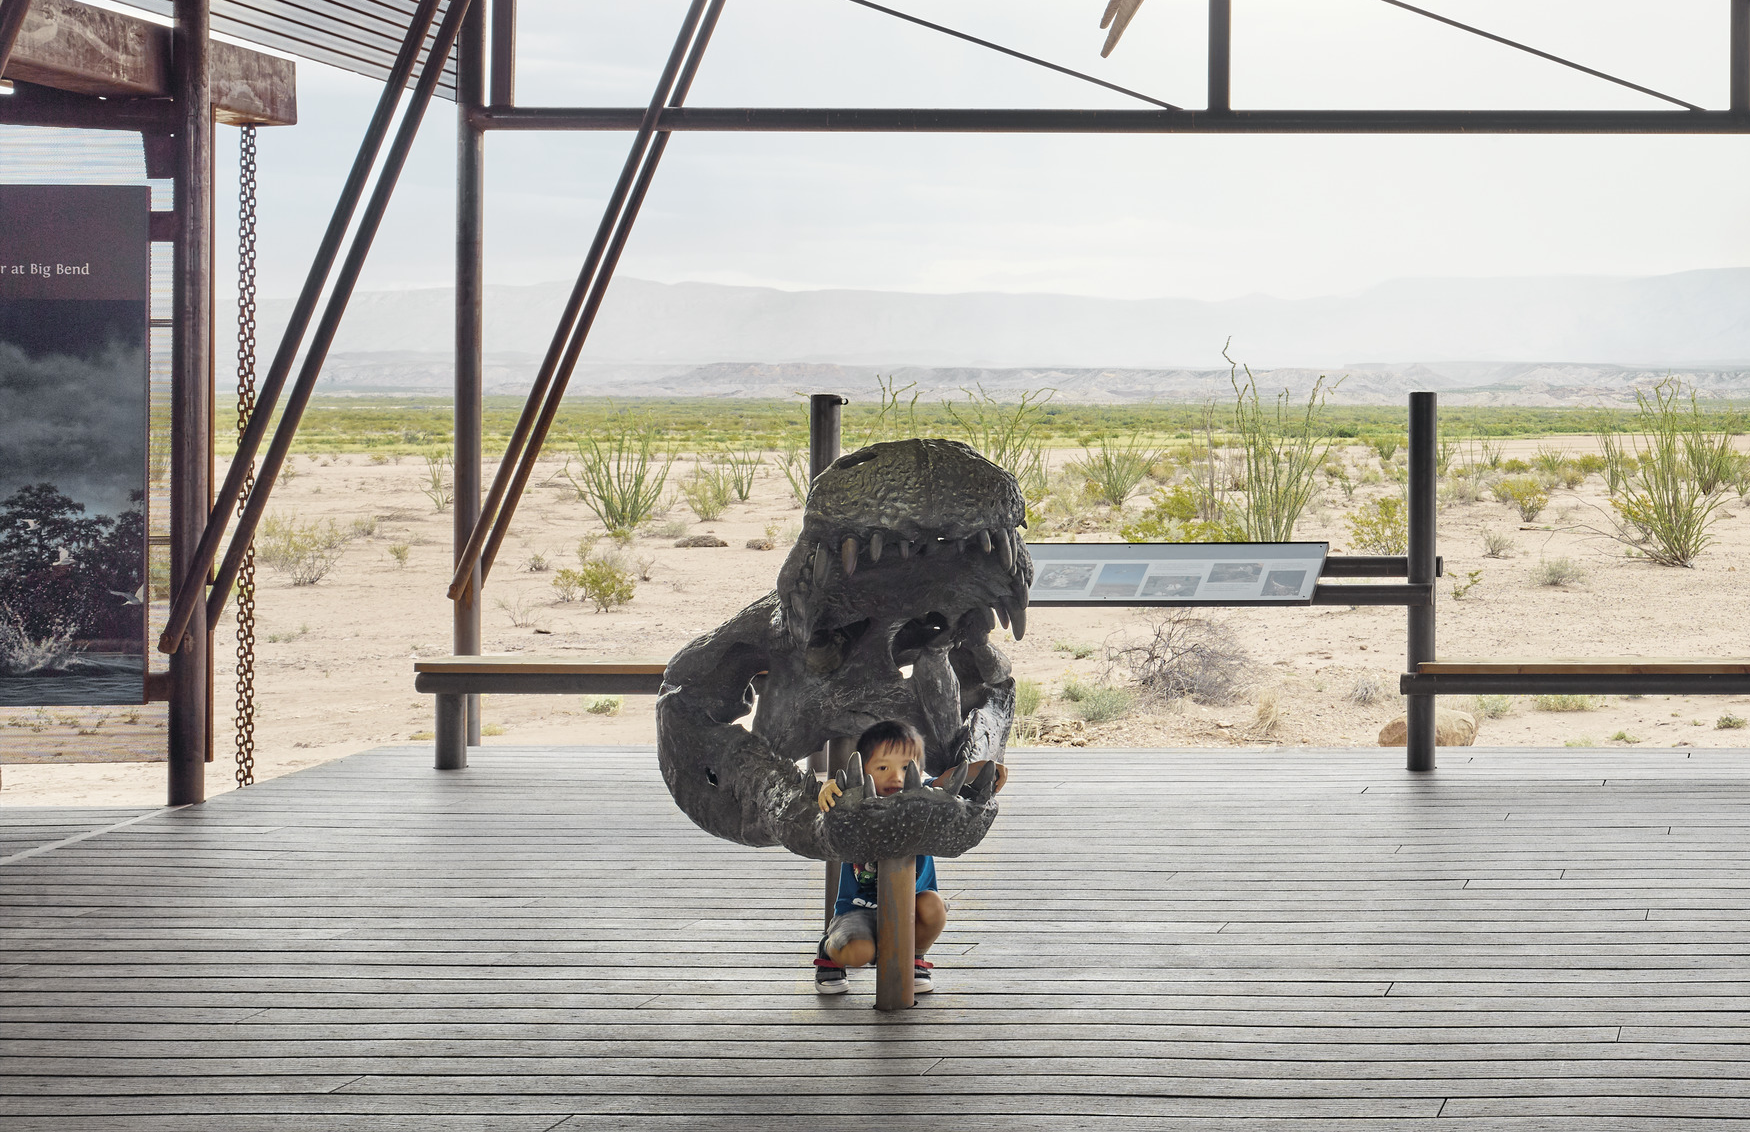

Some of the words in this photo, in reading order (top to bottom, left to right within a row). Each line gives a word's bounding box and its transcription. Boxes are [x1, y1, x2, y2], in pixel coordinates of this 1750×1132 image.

[11, 265, 25, 275] at
[30, 263, 51, 279] Big
[56, 262, 90, 275] Bend
